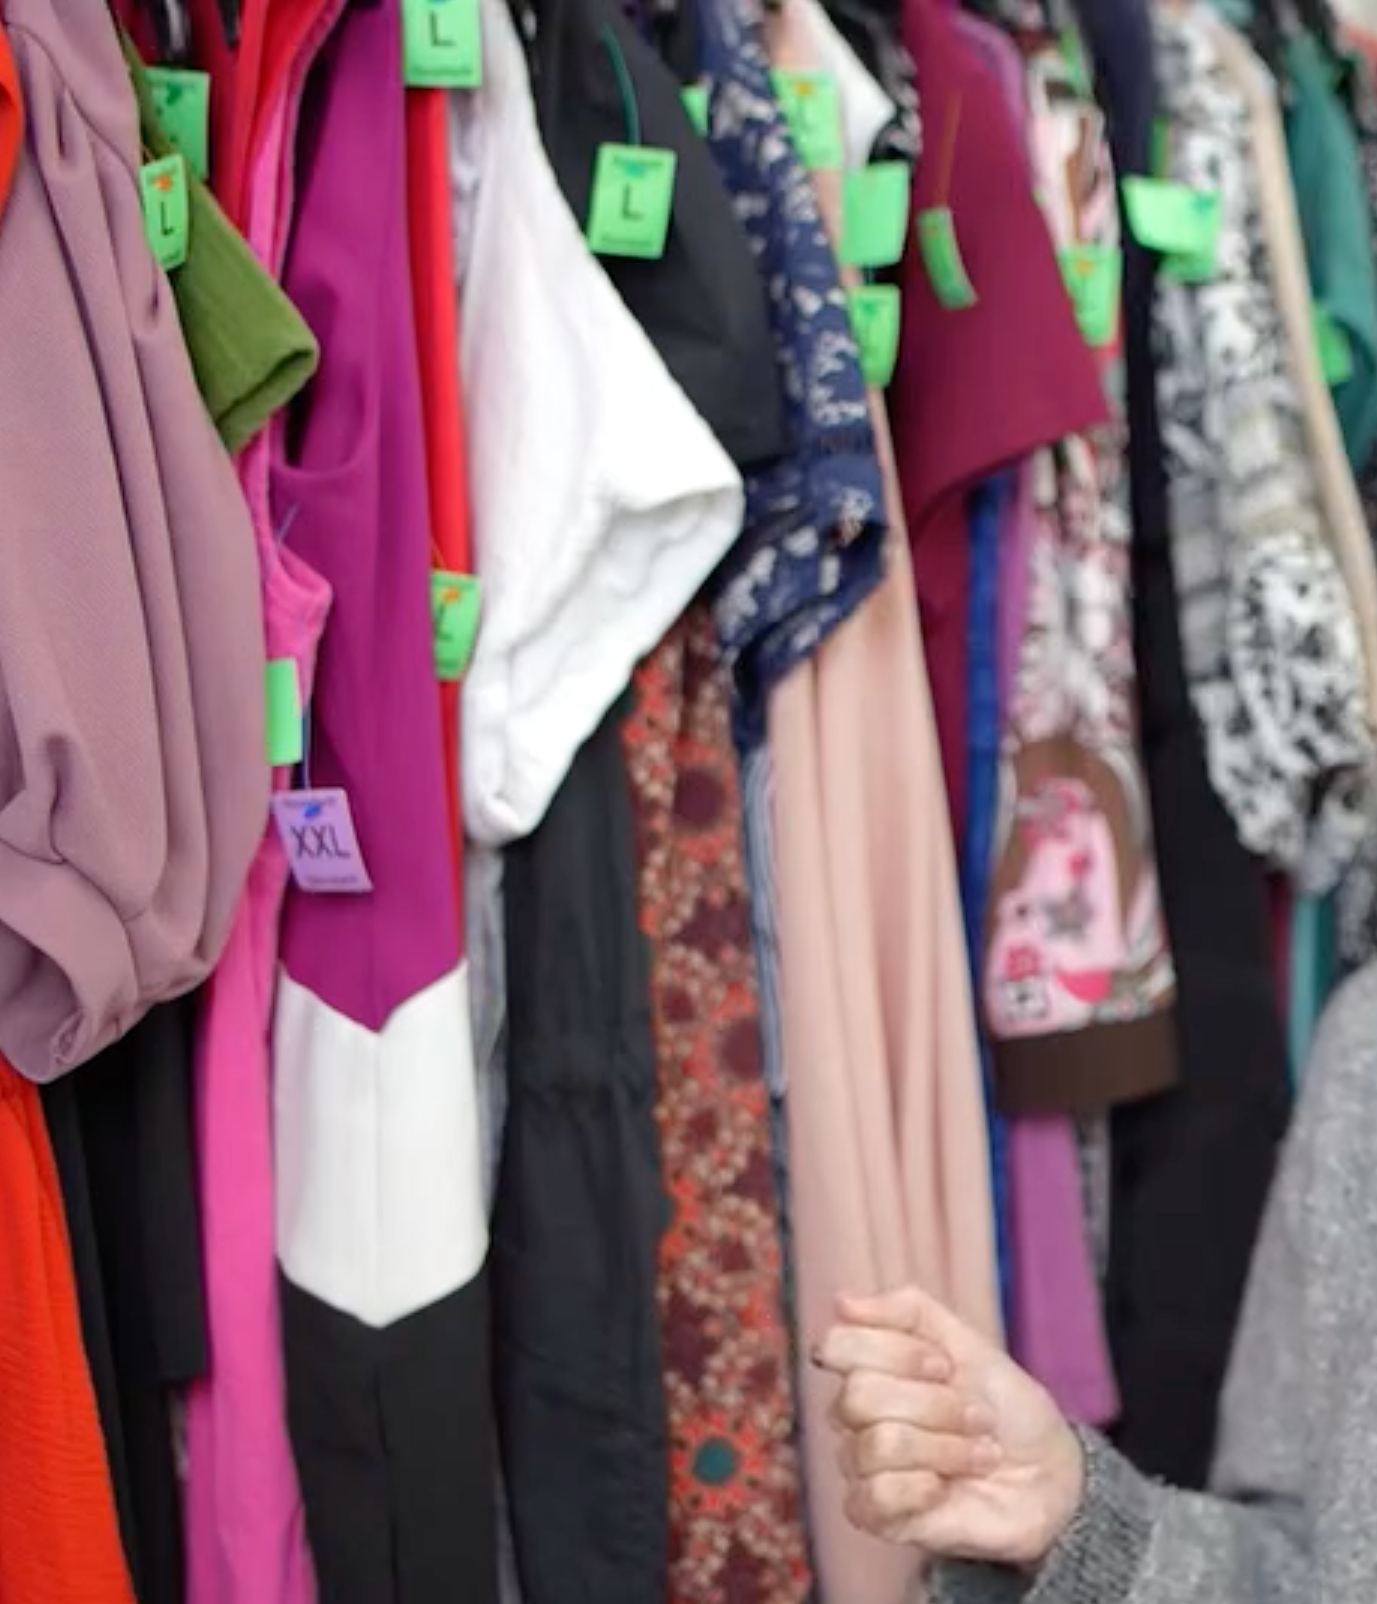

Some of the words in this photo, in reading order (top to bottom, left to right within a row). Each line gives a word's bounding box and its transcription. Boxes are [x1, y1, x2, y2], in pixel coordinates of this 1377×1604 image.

[429, 9, 457, 48] L
[160, 201, 175, 236] L
[622, 183, 646, 221] L
[290, 825, 351, 858] XXL
